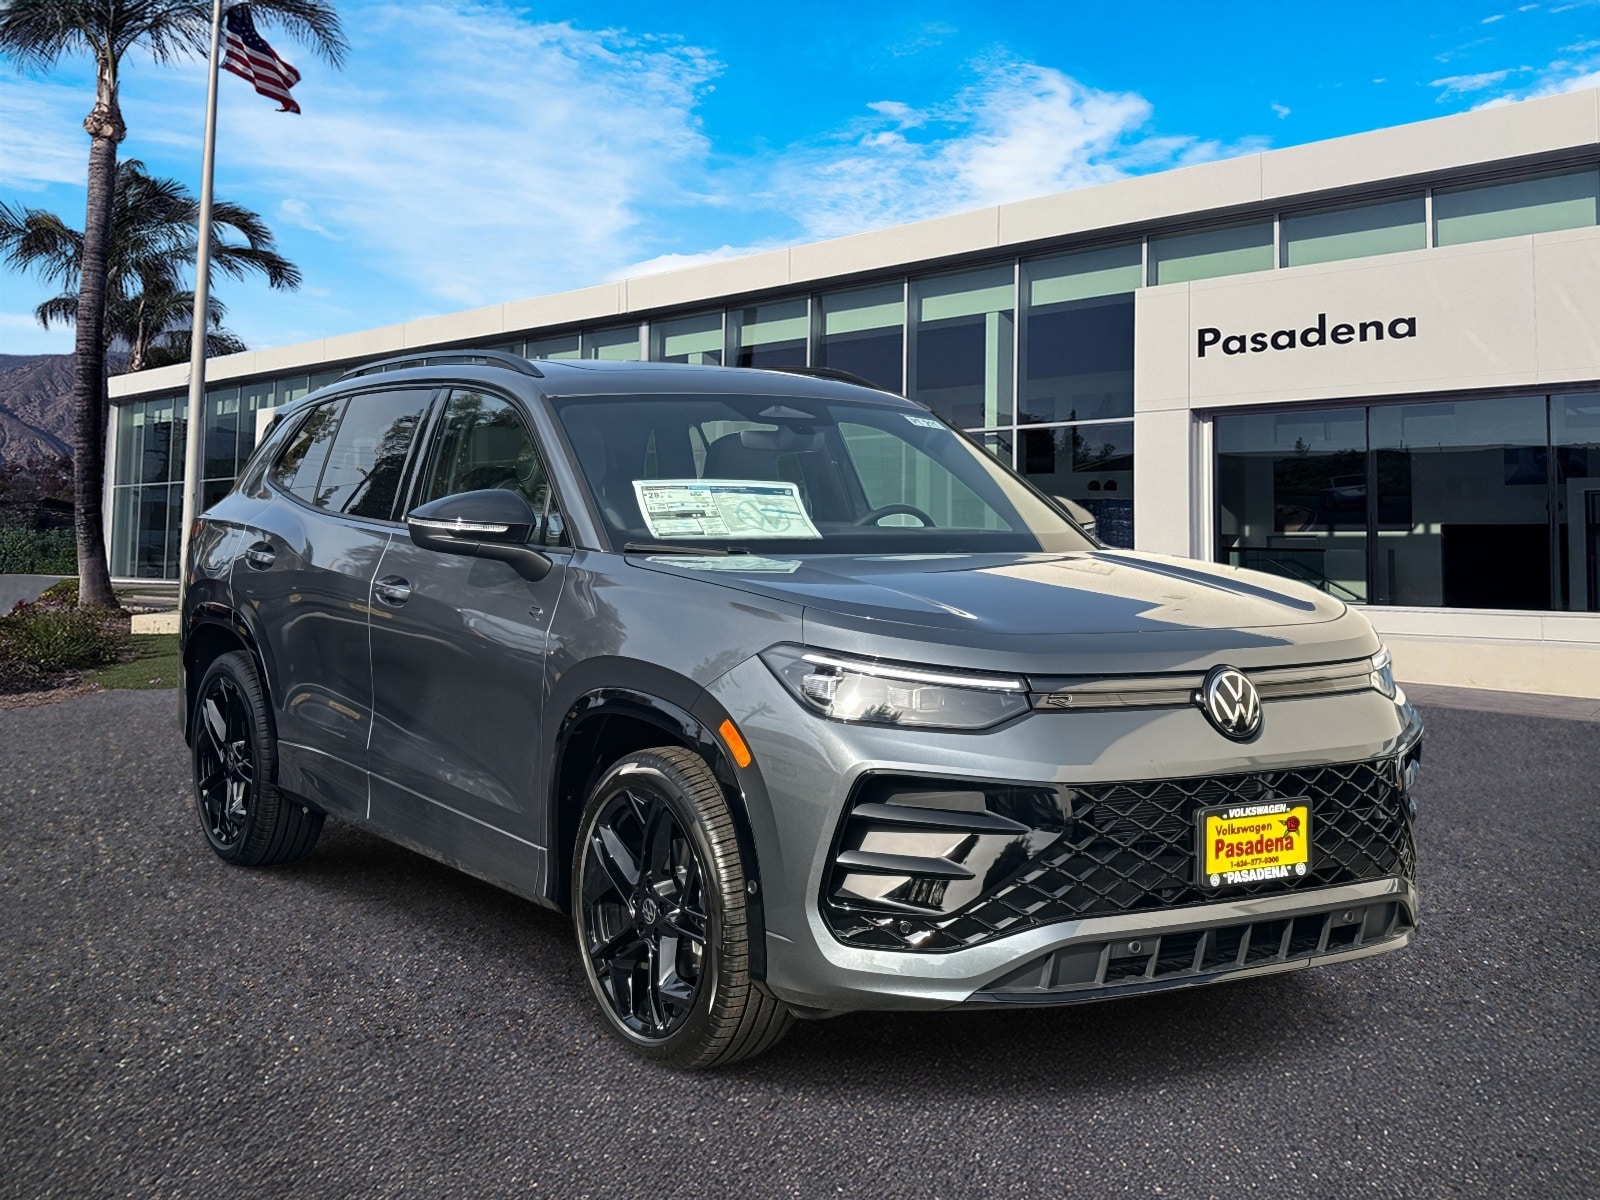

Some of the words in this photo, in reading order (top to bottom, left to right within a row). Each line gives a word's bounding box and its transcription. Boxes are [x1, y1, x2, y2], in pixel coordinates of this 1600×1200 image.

[1197, 313, 1417, 358] Pasadena
[1229, 803, 1286, 818] VOLKSWAGEN
[1215, 823, 1273, 836] Volkswagen
[1215, 834, 1294, 859] Pasadena
